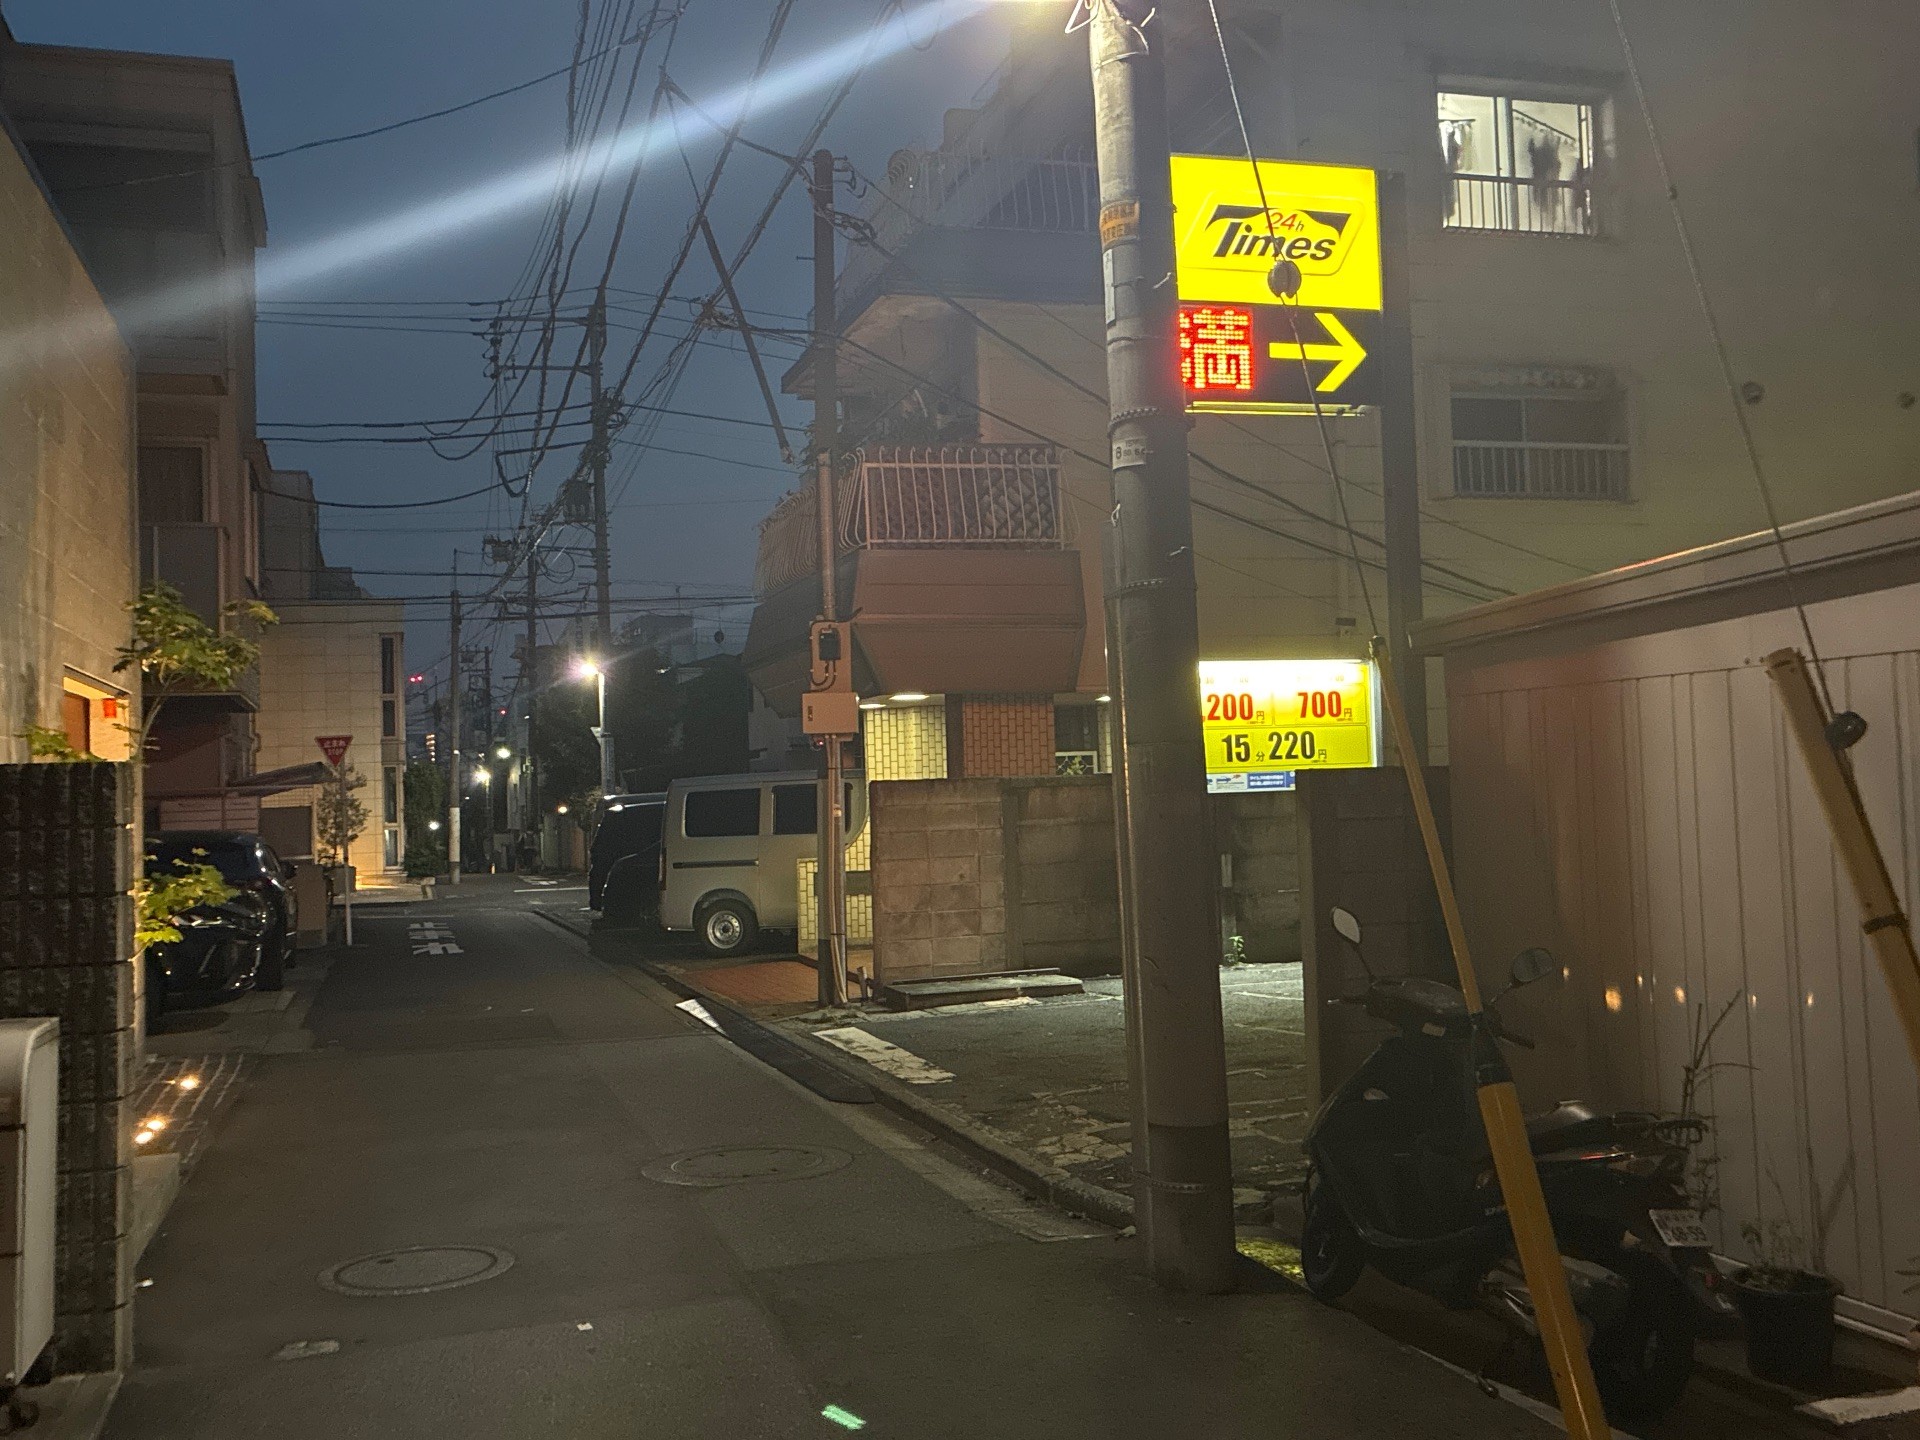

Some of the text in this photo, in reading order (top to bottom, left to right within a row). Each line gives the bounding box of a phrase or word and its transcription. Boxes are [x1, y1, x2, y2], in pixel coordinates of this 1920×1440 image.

[1205, 204, 1349, 261] Times
[1265, 212, 1304, 232] 24h
[1180, 308, 1251, 390] 満
